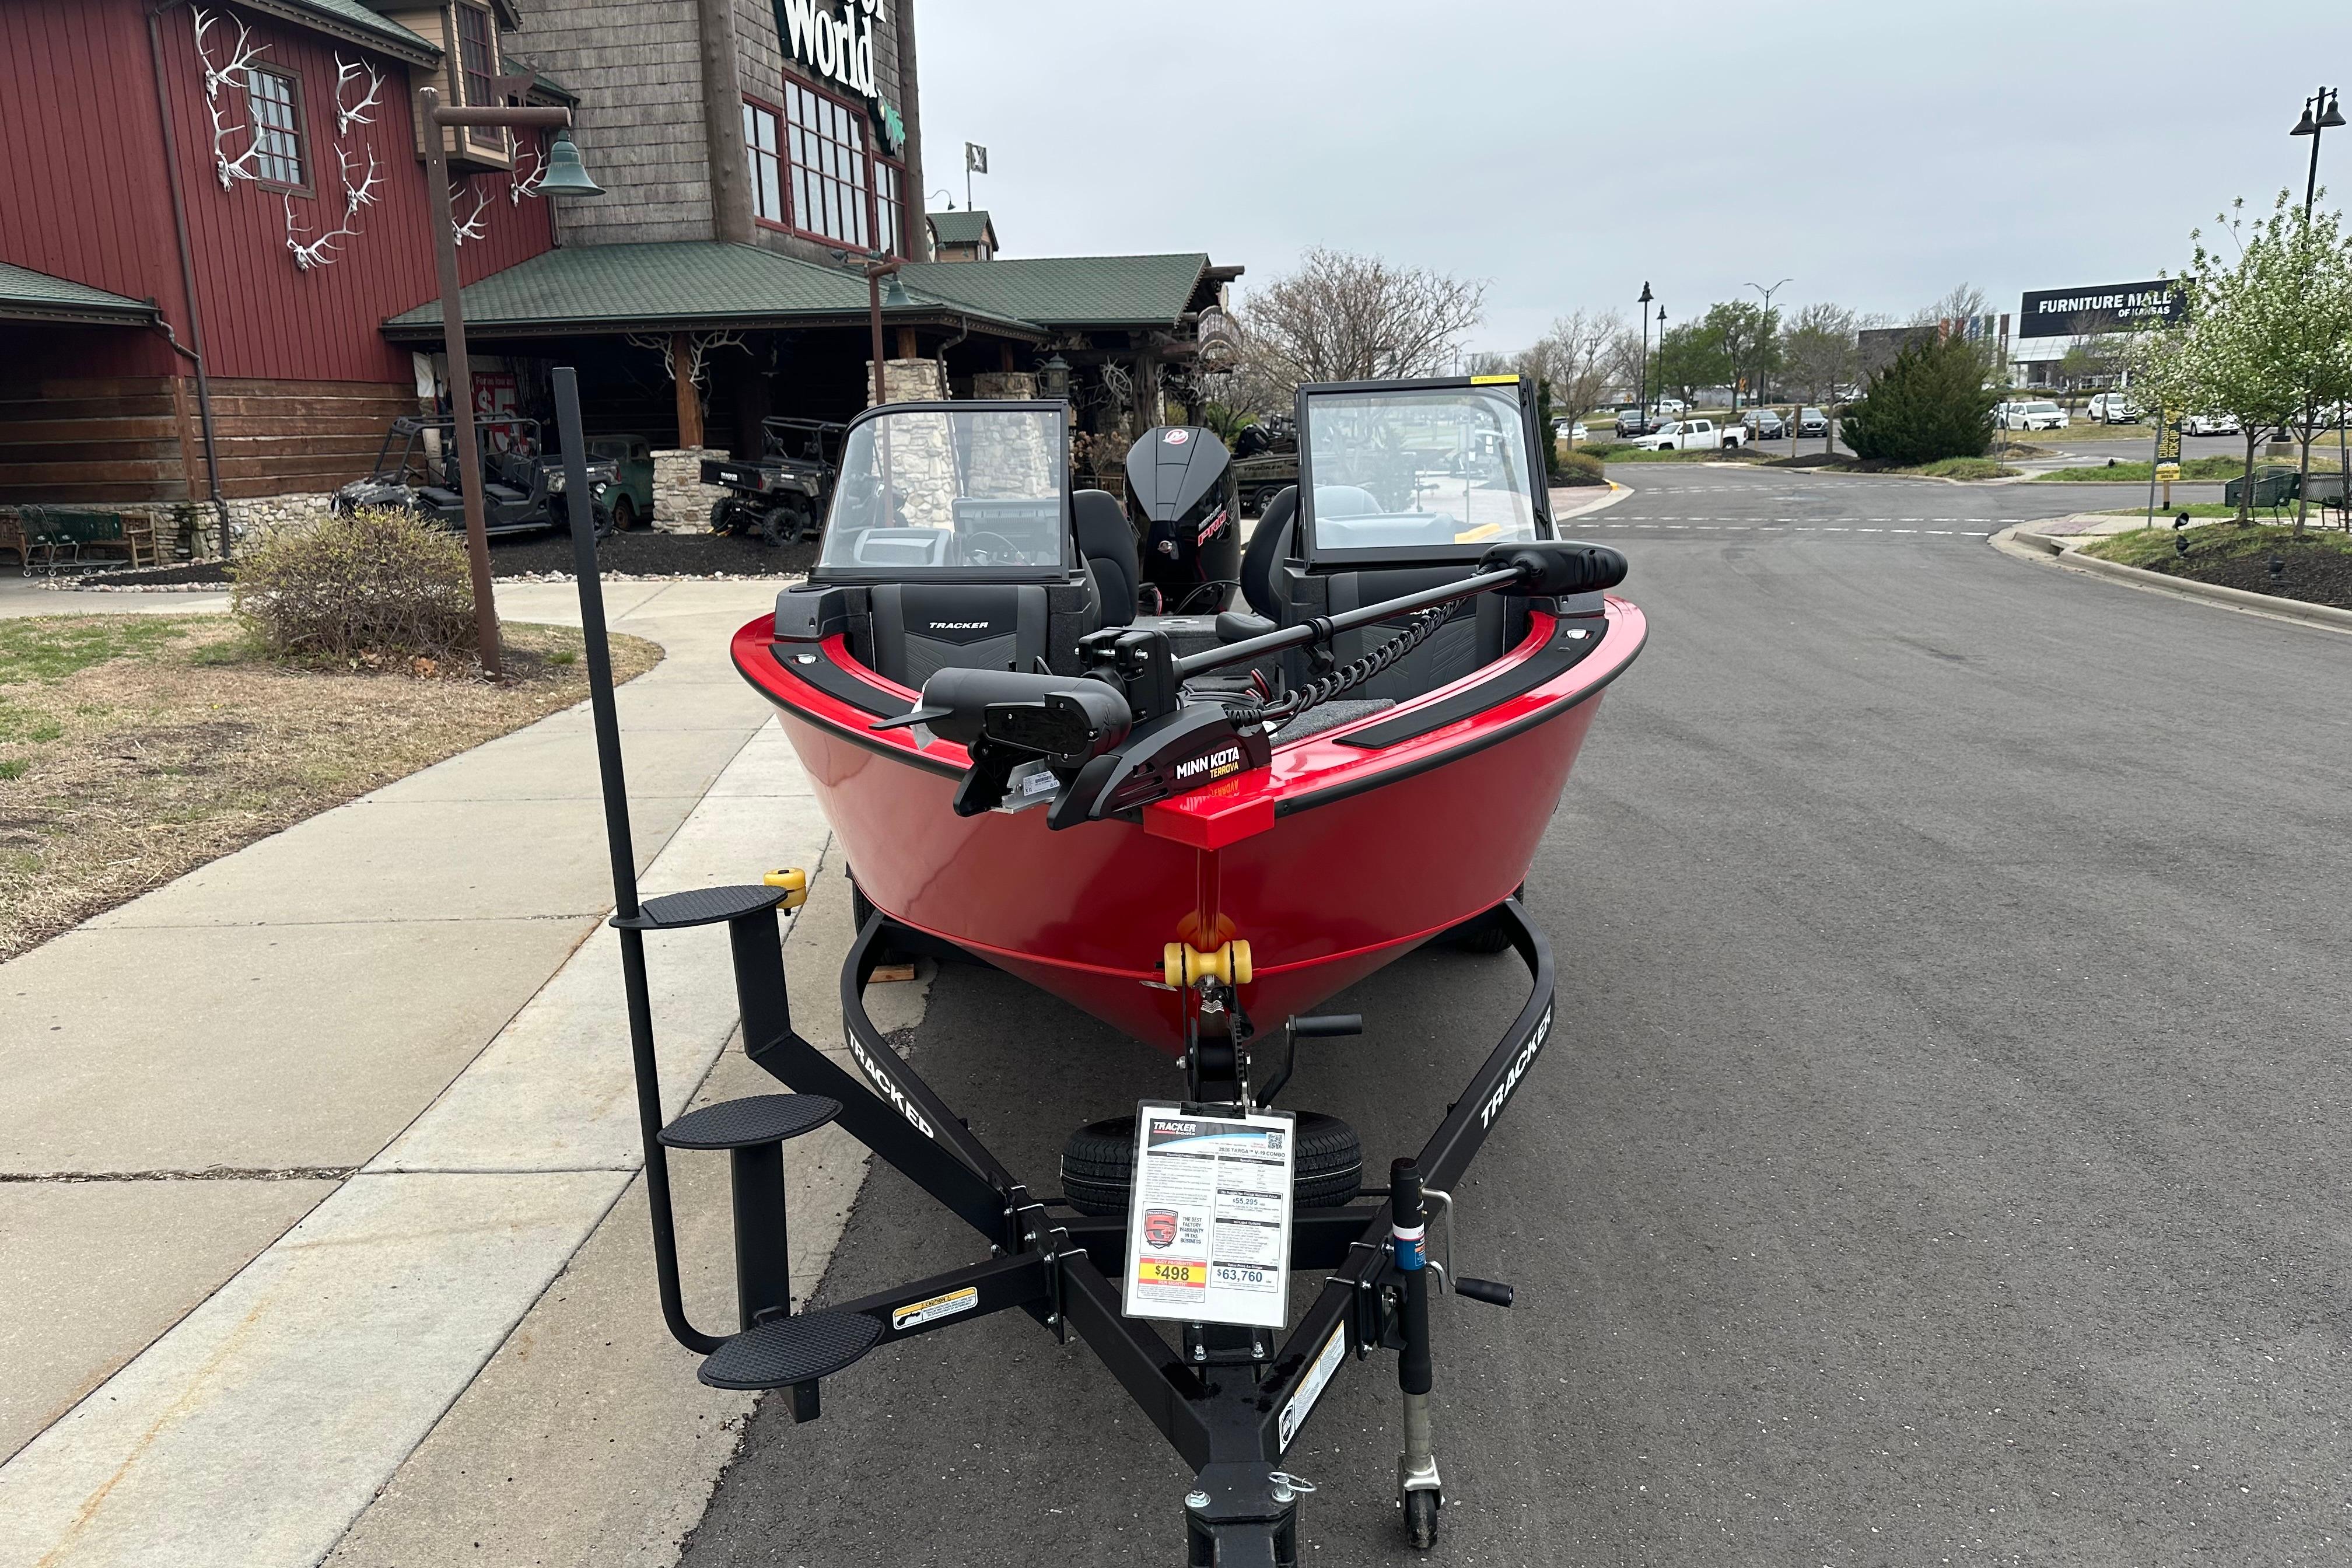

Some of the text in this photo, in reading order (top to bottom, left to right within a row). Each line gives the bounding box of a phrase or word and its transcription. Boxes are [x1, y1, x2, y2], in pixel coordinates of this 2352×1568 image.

[784, 0, 877, 98] World
[2039, 291, 2172, 314] FURNITURE MALL
[2118, 308, 2131, 317] OF
[2168, 429, 2179, 458] PICK-UP
[1177, 746, 1240, 779] MINN KOTA
[1210, 761, 1239, 779] TERROVA
[1481, 1005, 1551, 1129] TRACKER
[1154, 1121, 1196, 1132] TRACKER
[1155, 1265, 1189, 1281] $498
[1217, 1269, 1263, 1282] $63,760
[925, 1297, 946, 1307] CAUTION
